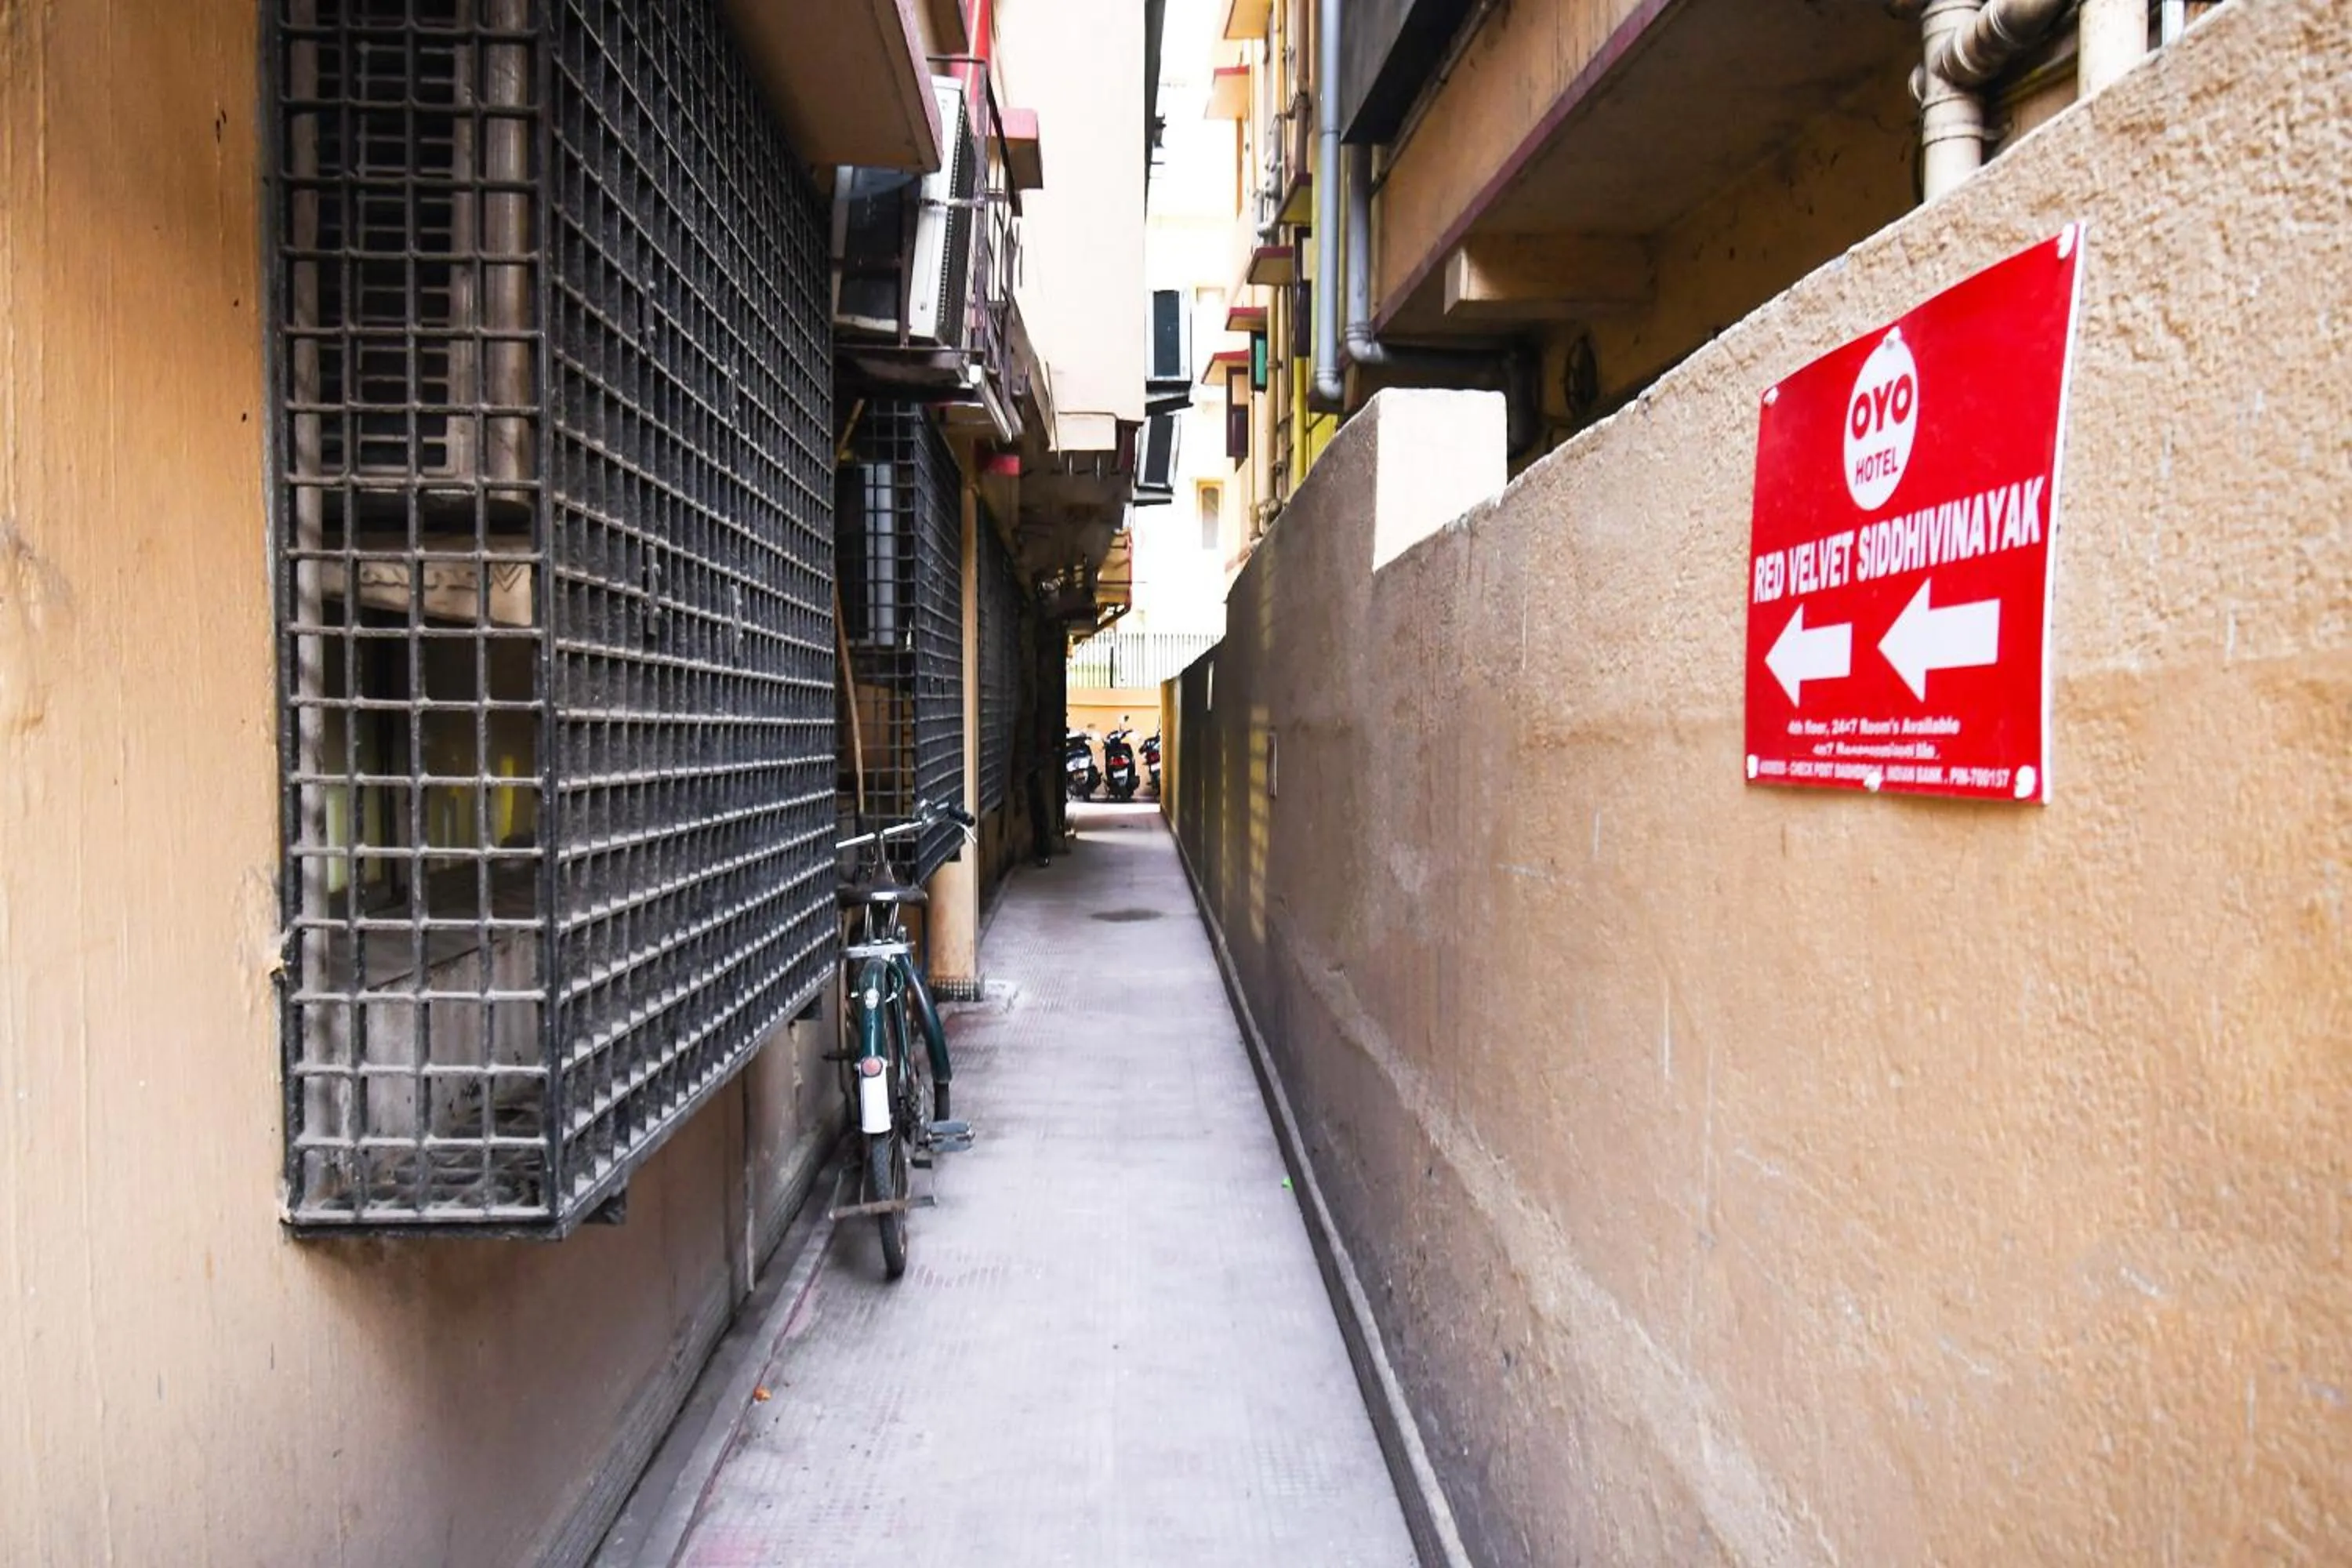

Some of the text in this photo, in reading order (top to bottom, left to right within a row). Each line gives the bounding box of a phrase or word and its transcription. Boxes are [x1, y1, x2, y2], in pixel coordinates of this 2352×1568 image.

[1852, 373, 1913, 440] OYO
[1856, 447, 1898, 486] HOTEL
[1754, 475, 2045, 604] RED VELVET SIDDHIVINAYAK
[1901, 715, 1960, 735] Available
